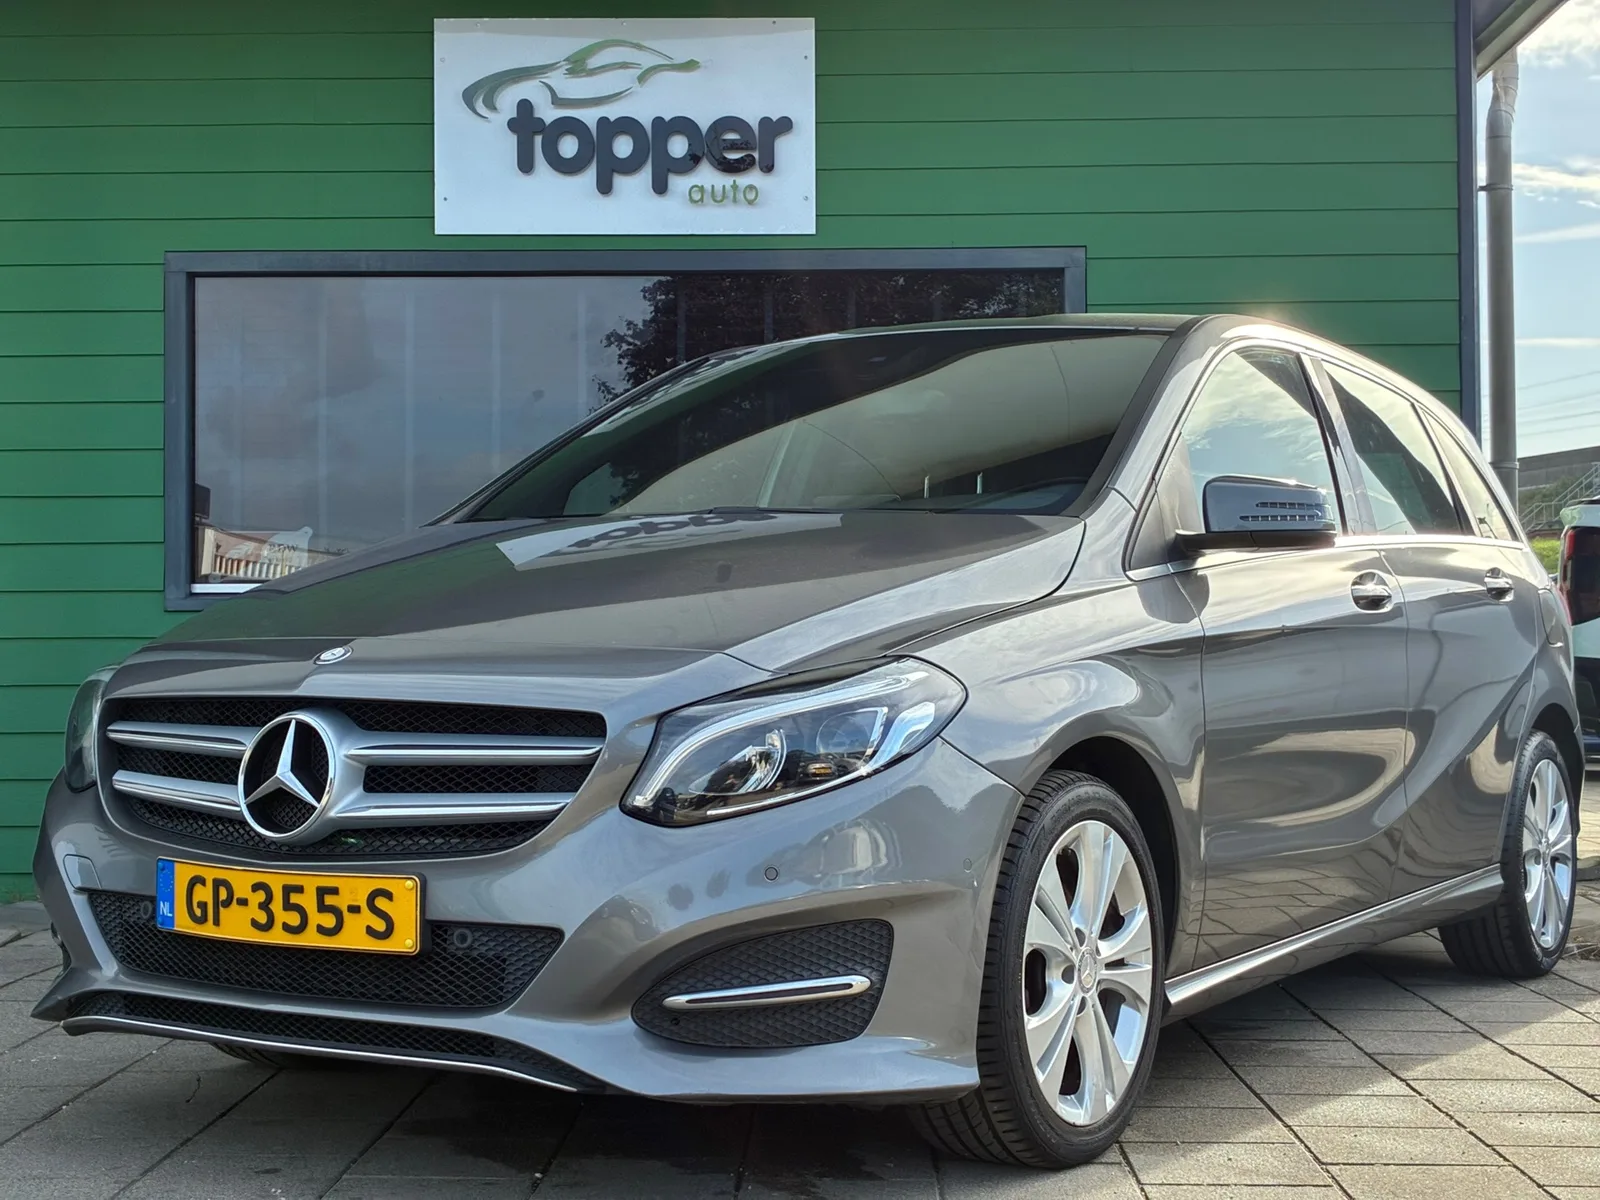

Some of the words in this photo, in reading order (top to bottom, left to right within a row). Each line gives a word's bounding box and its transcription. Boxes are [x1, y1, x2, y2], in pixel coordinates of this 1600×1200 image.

[507, 98, 794, 195] topper
[688, 179, 759, 205] auto
[159, 900, 173, 917] NL
[185, 874, 395, 941] GP-355-S
